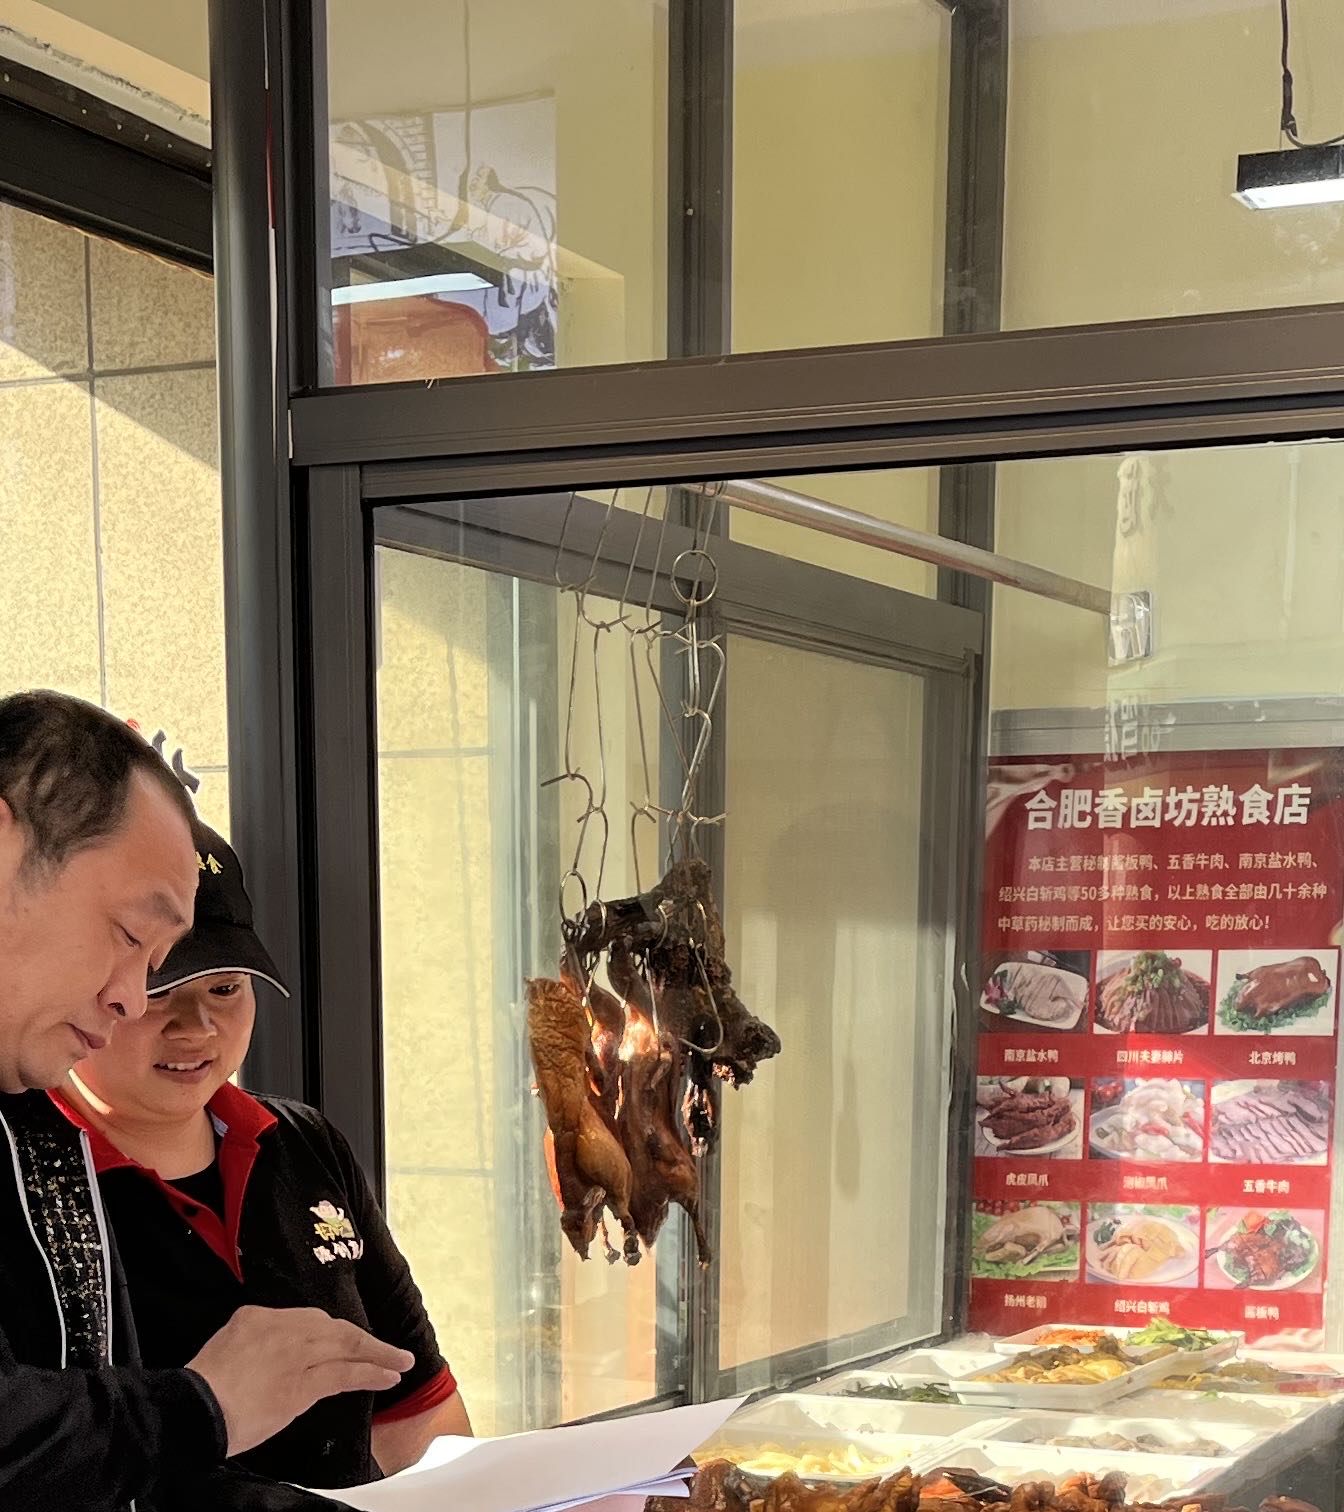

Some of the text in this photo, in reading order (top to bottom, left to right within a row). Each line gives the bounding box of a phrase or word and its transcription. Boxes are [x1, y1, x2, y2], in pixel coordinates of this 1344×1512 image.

[1025, 783, 1312, 831] 合肥香卤坊熟食店
[1004, 1049, 1059, 1063] 南京盐水鸭
[1249, 1051, 1297, 1065] 北京烤鸭
[1243, 1179, 1291, 1194] 五香牛肉
